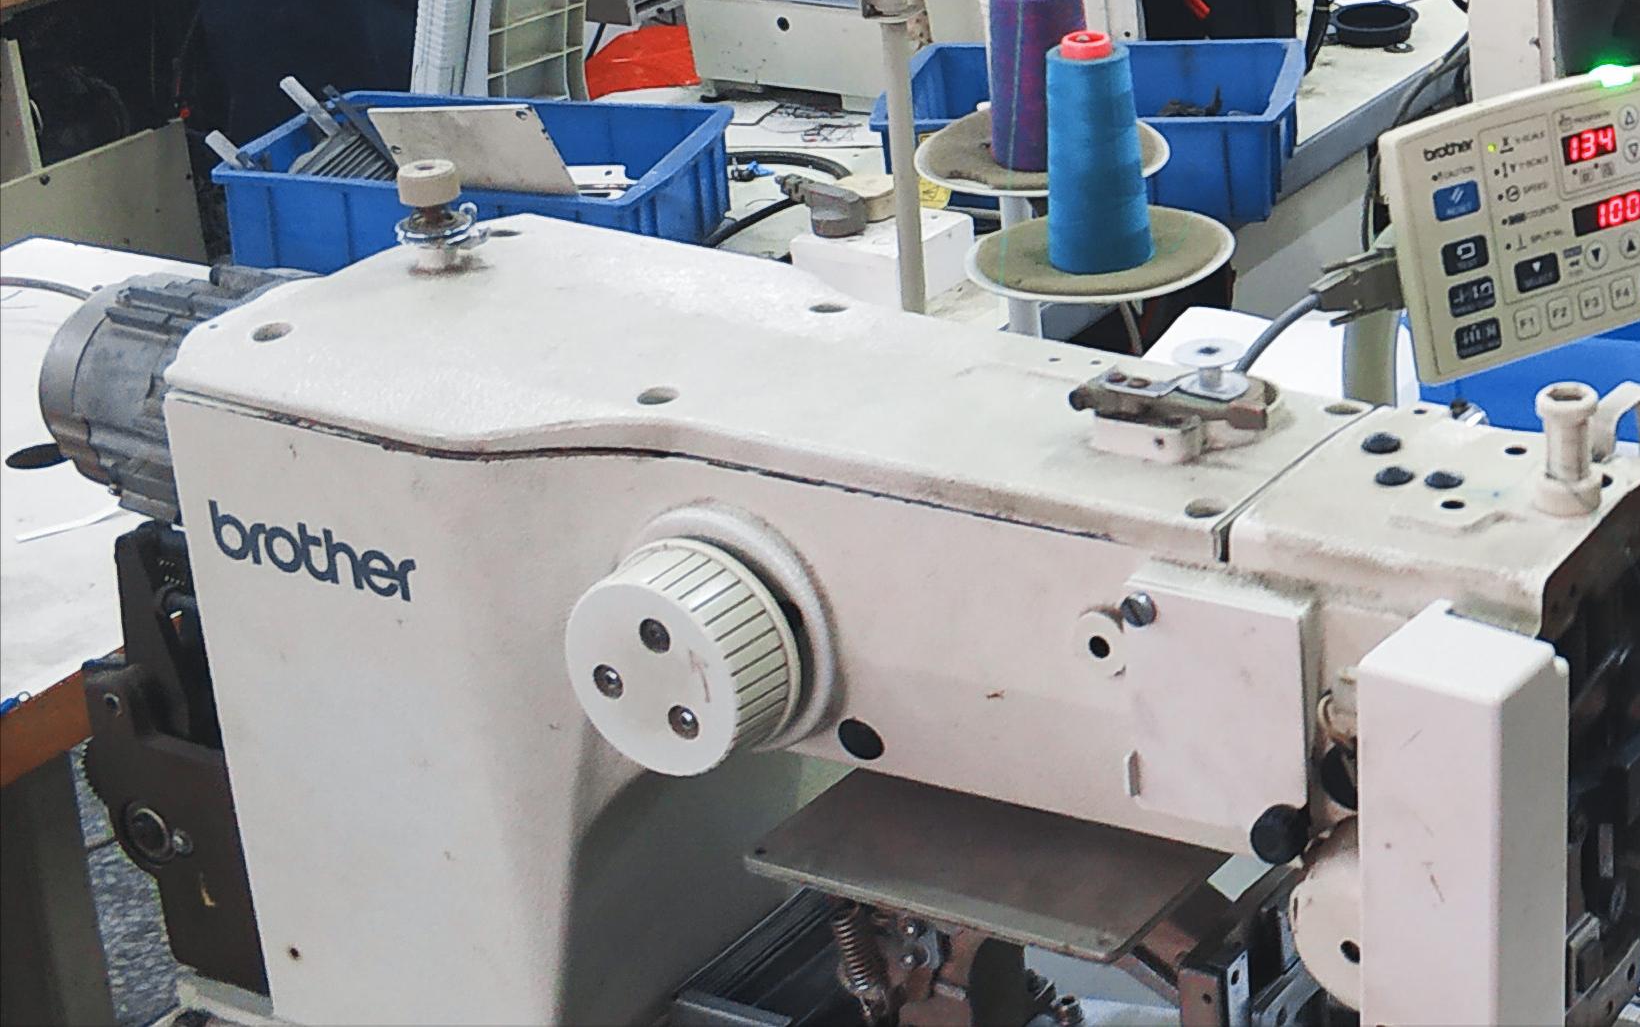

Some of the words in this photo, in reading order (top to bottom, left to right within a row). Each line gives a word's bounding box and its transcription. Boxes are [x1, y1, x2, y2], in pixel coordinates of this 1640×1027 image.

[1423, 138, 1473, 162] brother
[1569, 127, 1614, 161] 134
[1598, 192, 1640, 227] 100
[1520, 317, 1535, 329] F1
[1552, 307, 1567, 318] F2
[1584, 296, 1599, 309] F3
[1615, 287, 1630, 299] F4
[208, 499, 416, 602] brother
